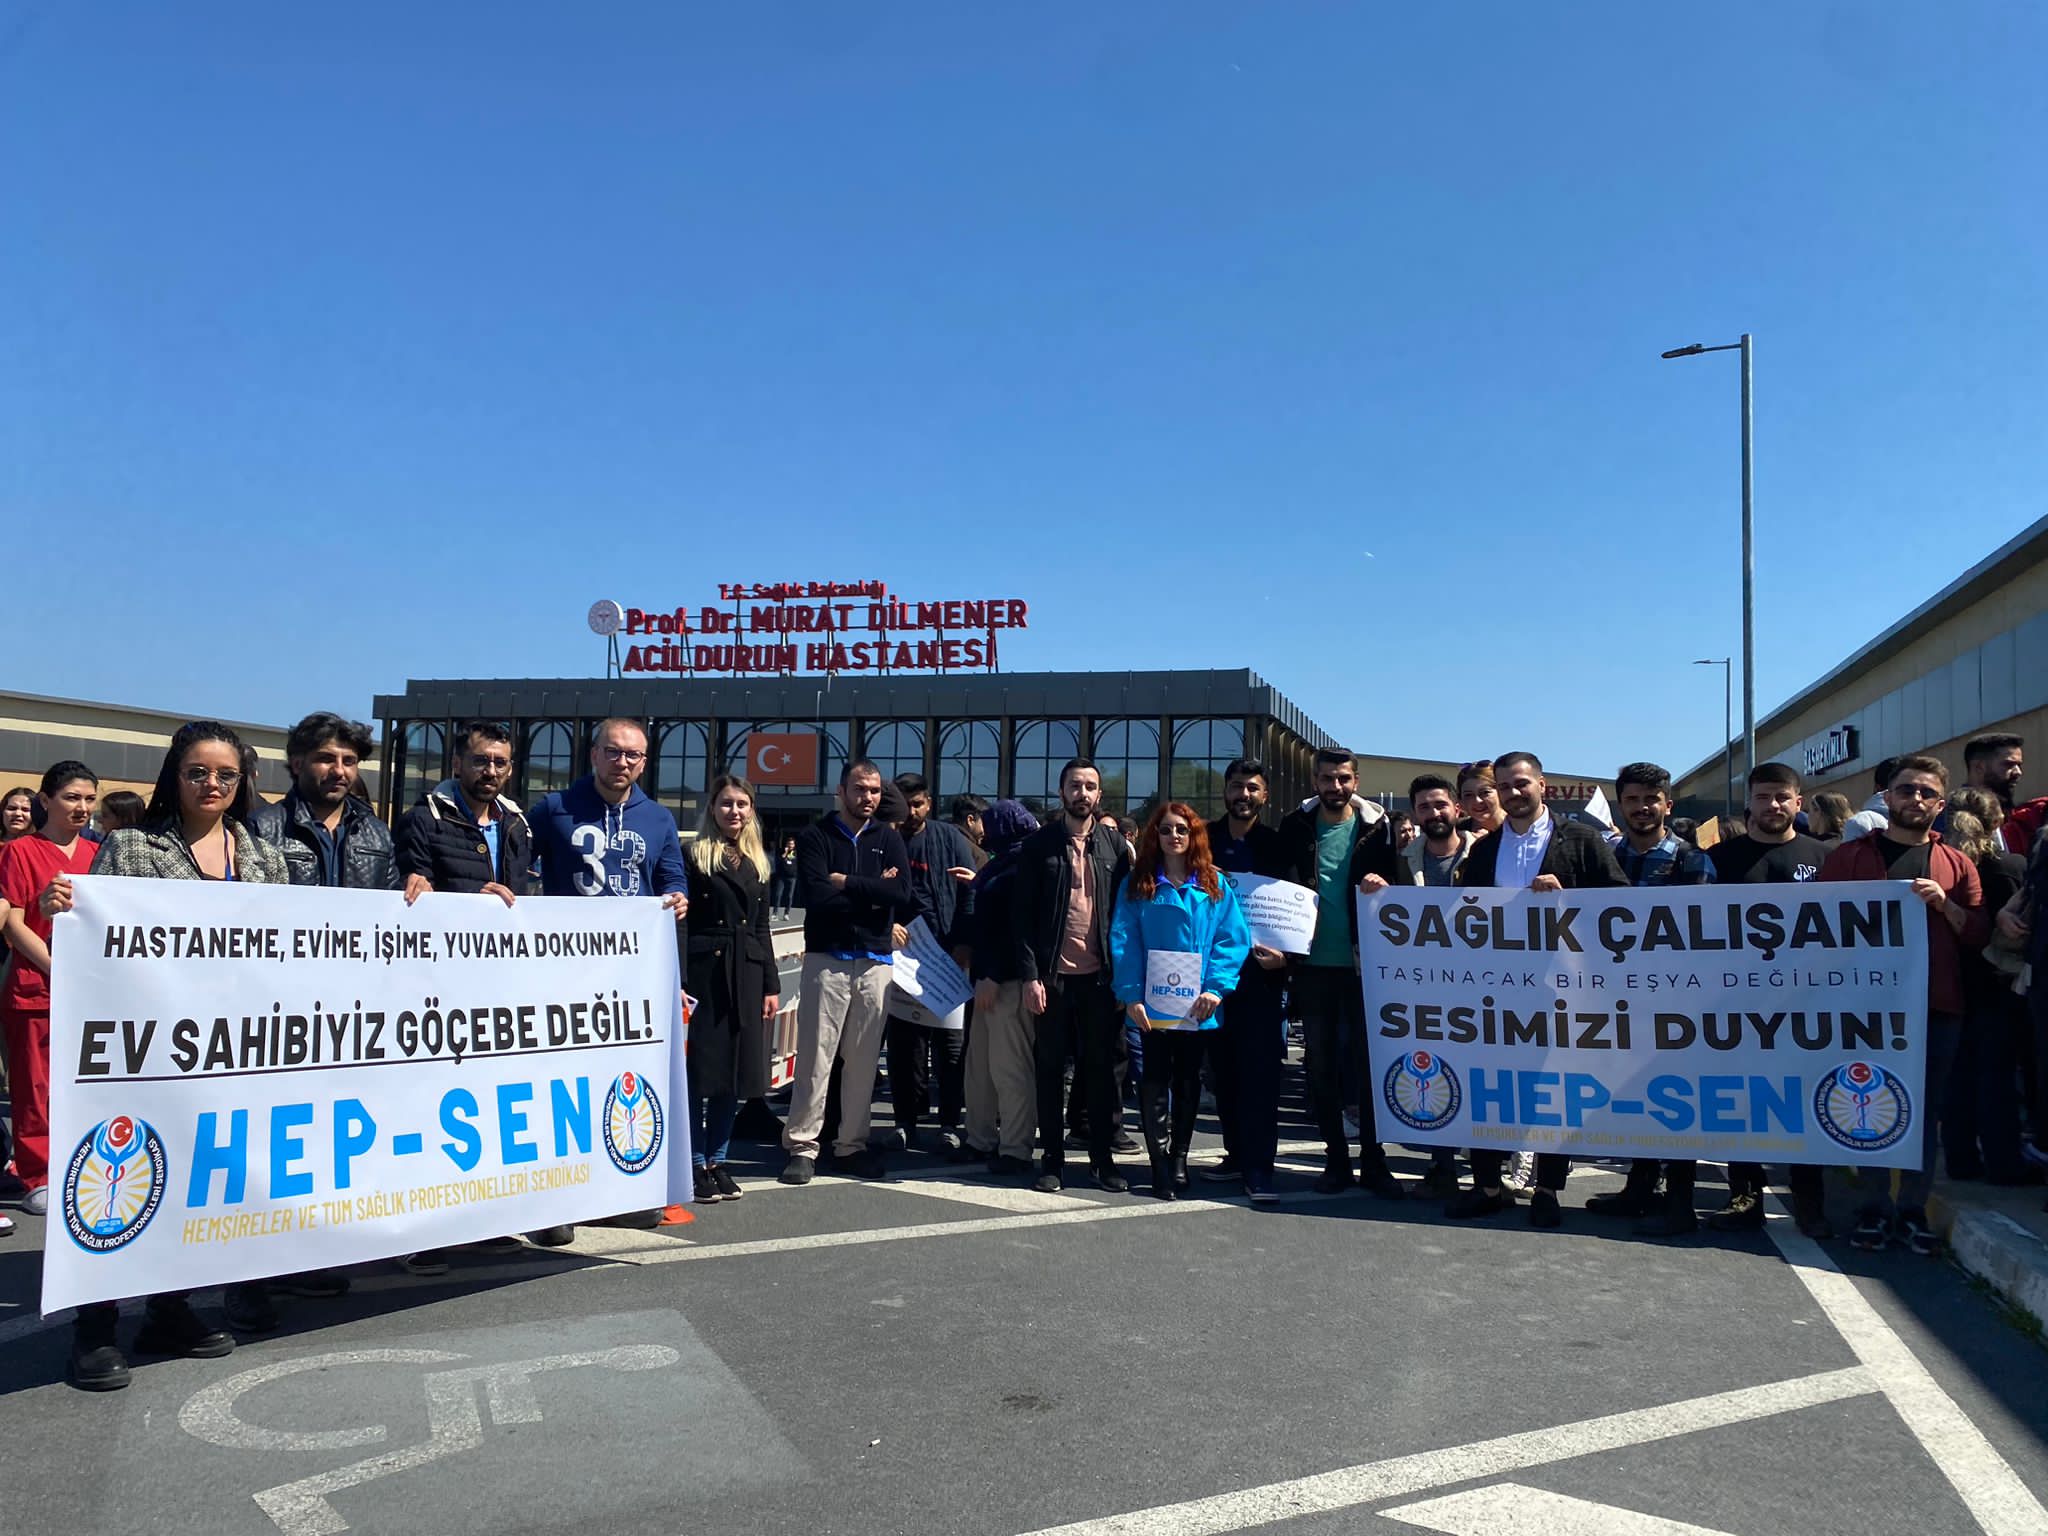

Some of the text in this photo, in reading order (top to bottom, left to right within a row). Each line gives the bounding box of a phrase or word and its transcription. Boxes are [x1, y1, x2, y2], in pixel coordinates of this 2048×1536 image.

[627, 607, 693, 635] Prof.
[701, 607, 742, 634] Dr.
[751, 602, 854, 634] MURAT
[868, 594, 1028, 632] DİLMENER
[623, 631, 994, 672] ACİL DURUM HASTANESİ
[571, 825, 646, 896] 33
[104, 922, 639, 966] HASTANEME, EVİME, İŞİME, YUVAMA DOKUNMA!
[1379, 895, 1905, 964] SAĞLIK ÇALIŞANI
[1152, 985, 1194, 998] HEP-SEN
[1376, 965, 1900, 991] TAŞINACAK BİR EŞYA DEĞİLDİR!
[79, 989, 653, 1075] EV SAHİBİYİZ GÖÇEBE DEĞİL!
[1380, 996, 1909, 1052] SESİMİZİ DUYUN!
[1470, 1068, 1804, 1133] HEP-SEN
[187, 1077, 592, 1208] HEP-SEN
[66, 1137, 165, 1249] HEMŞİRELER VE TÜM SAĞLIK PROFESYONELLERİ SENDİKASI
[183, 1208, 293, 1246] HEMŞİRELER
[298, 1204, 317, 1231] VE
[357, 1190, 405, 1221] SAĞLIK
[409, 1166, 529, 1212] PROFESYONELLERİ
[531, 1161, 590, 1192] SENDİKASI
